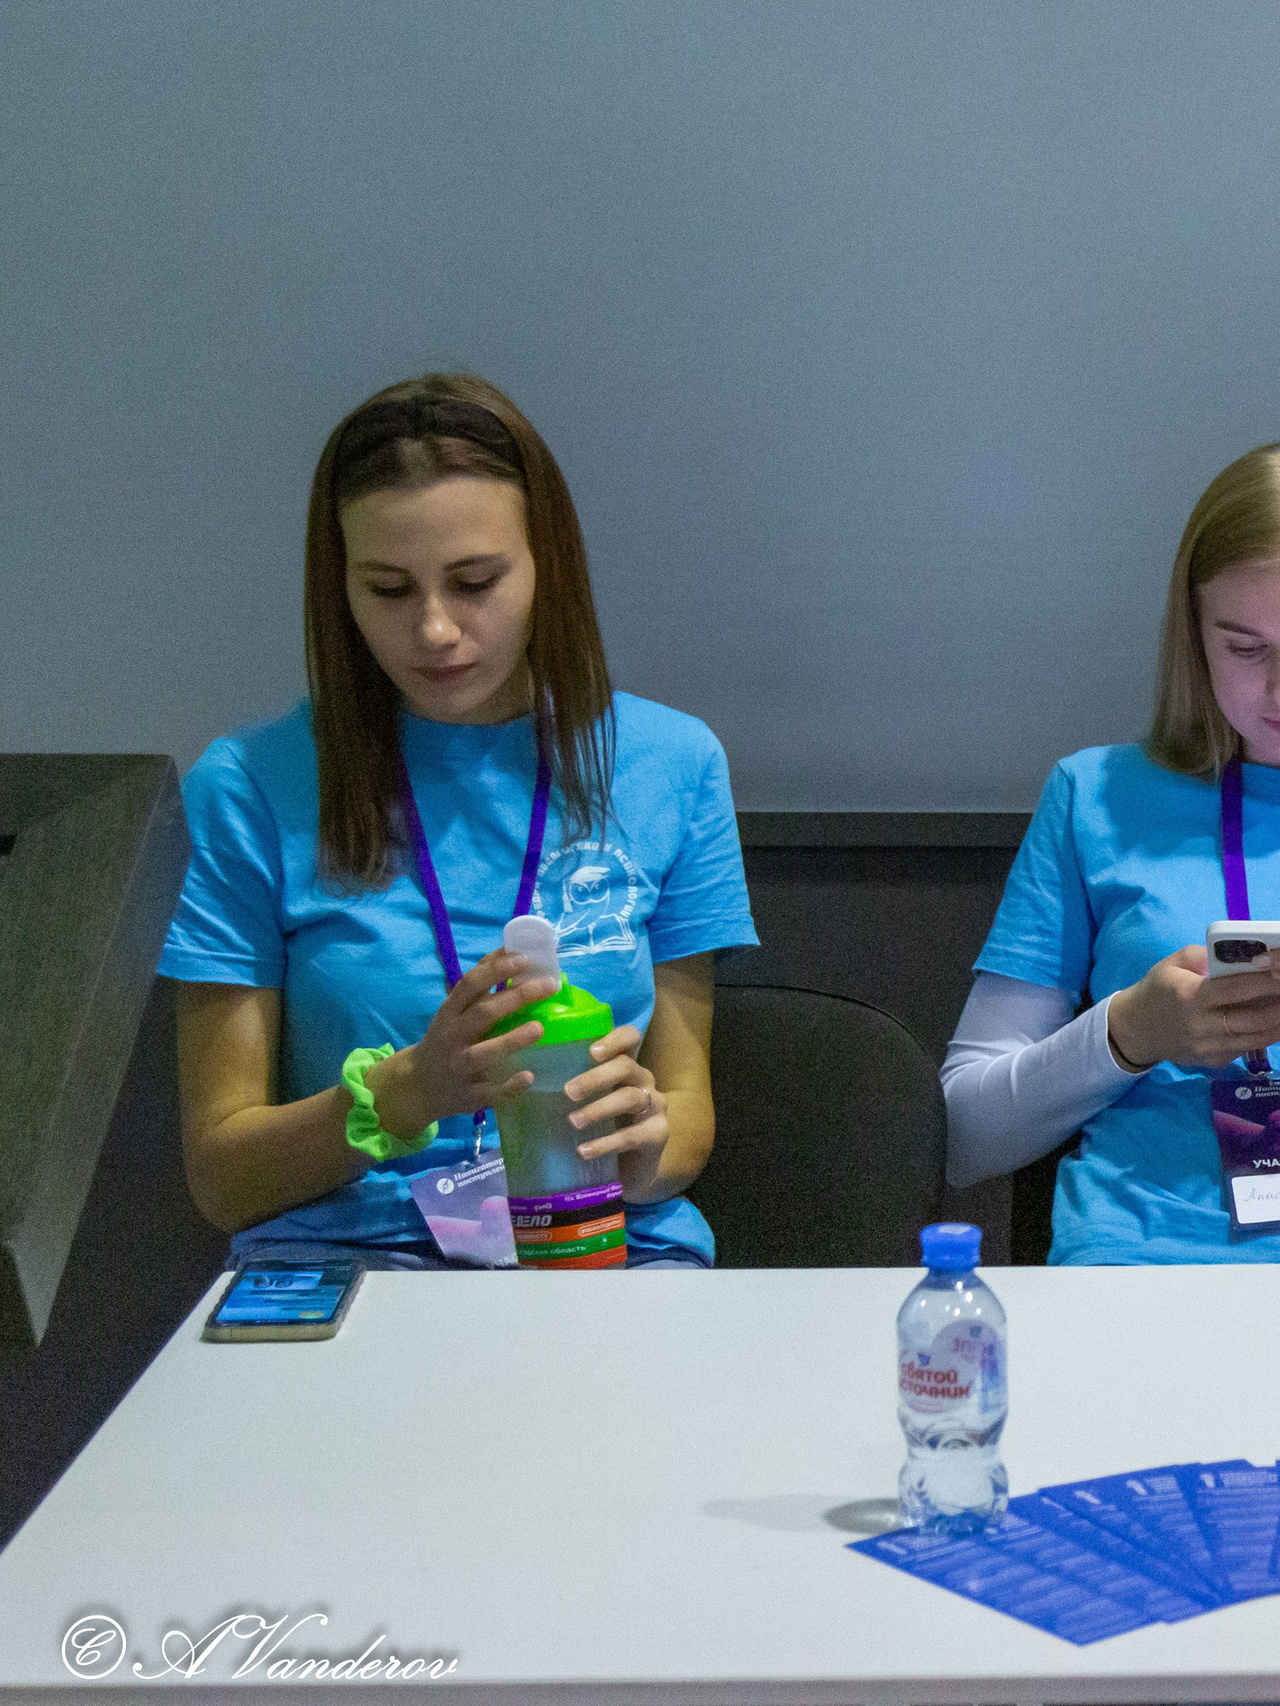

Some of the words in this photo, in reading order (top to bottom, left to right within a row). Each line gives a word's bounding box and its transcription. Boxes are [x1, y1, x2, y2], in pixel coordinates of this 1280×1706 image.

[453, 1157, 504, 1181] Навигатор
[457, 1165, 506, 1188] поступле
[550, 1245, 587, 1255] область
